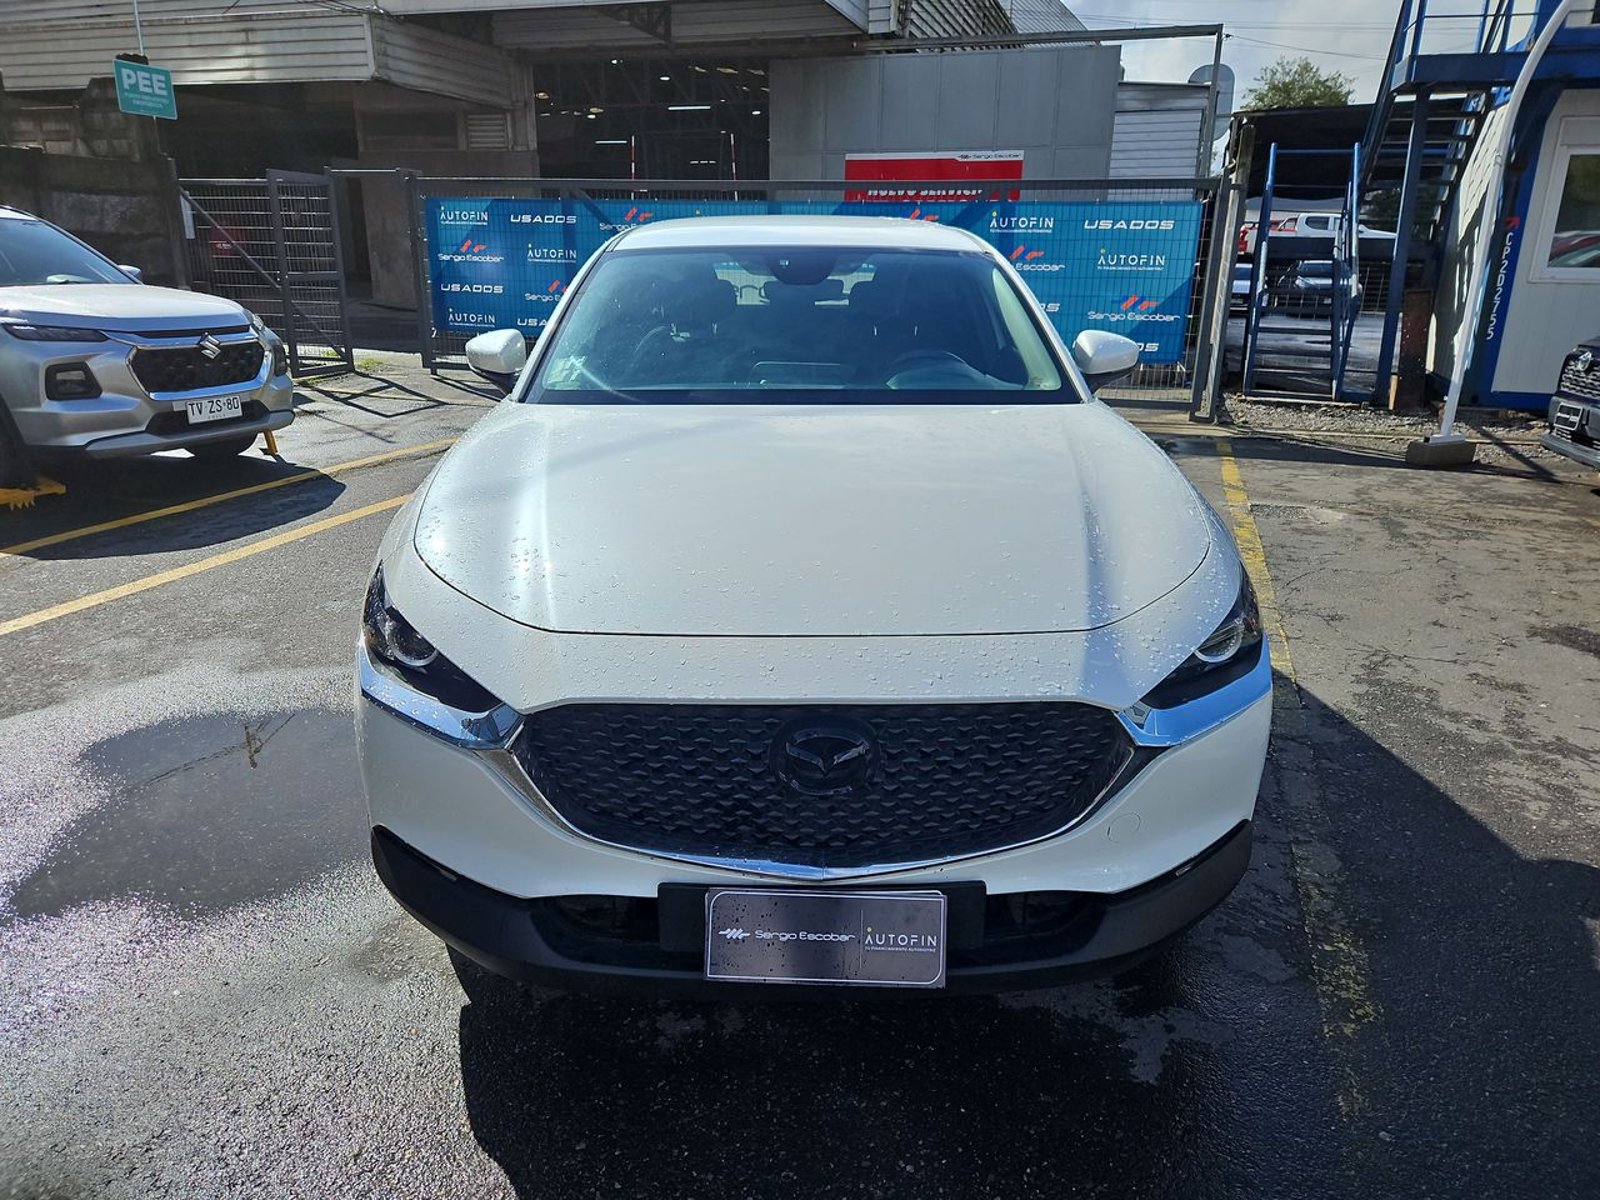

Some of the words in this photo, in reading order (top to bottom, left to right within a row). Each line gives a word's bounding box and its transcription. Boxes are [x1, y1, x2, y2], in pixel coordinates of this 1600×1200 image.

[121, 68, 168, 96] PEE
[440, 208, 489, 221] AUTOFIN
[510, 214, 577, 224] USADOS
[989, 213, 1054, 228] AUTOFIN
[1084, 219, 1175, 230] USADOS
[466, 254, 505, 262] Escobar
[527, 246, 577, 259] AUTOFIN
[1097, 251, 1165, 266] AUTOFIN
[1015, 262, 1066, 271] Escobar
[440, 283, 504, 294] USADOS
[448, 310, 496, 324] AUTOFIN
[517, 318, 548, 326] USA
[1127, 311, 1181, 322] Escobar
[799, 930, 856, 942] Escobar
[864, 930, 938, 947] AUTOFIN
